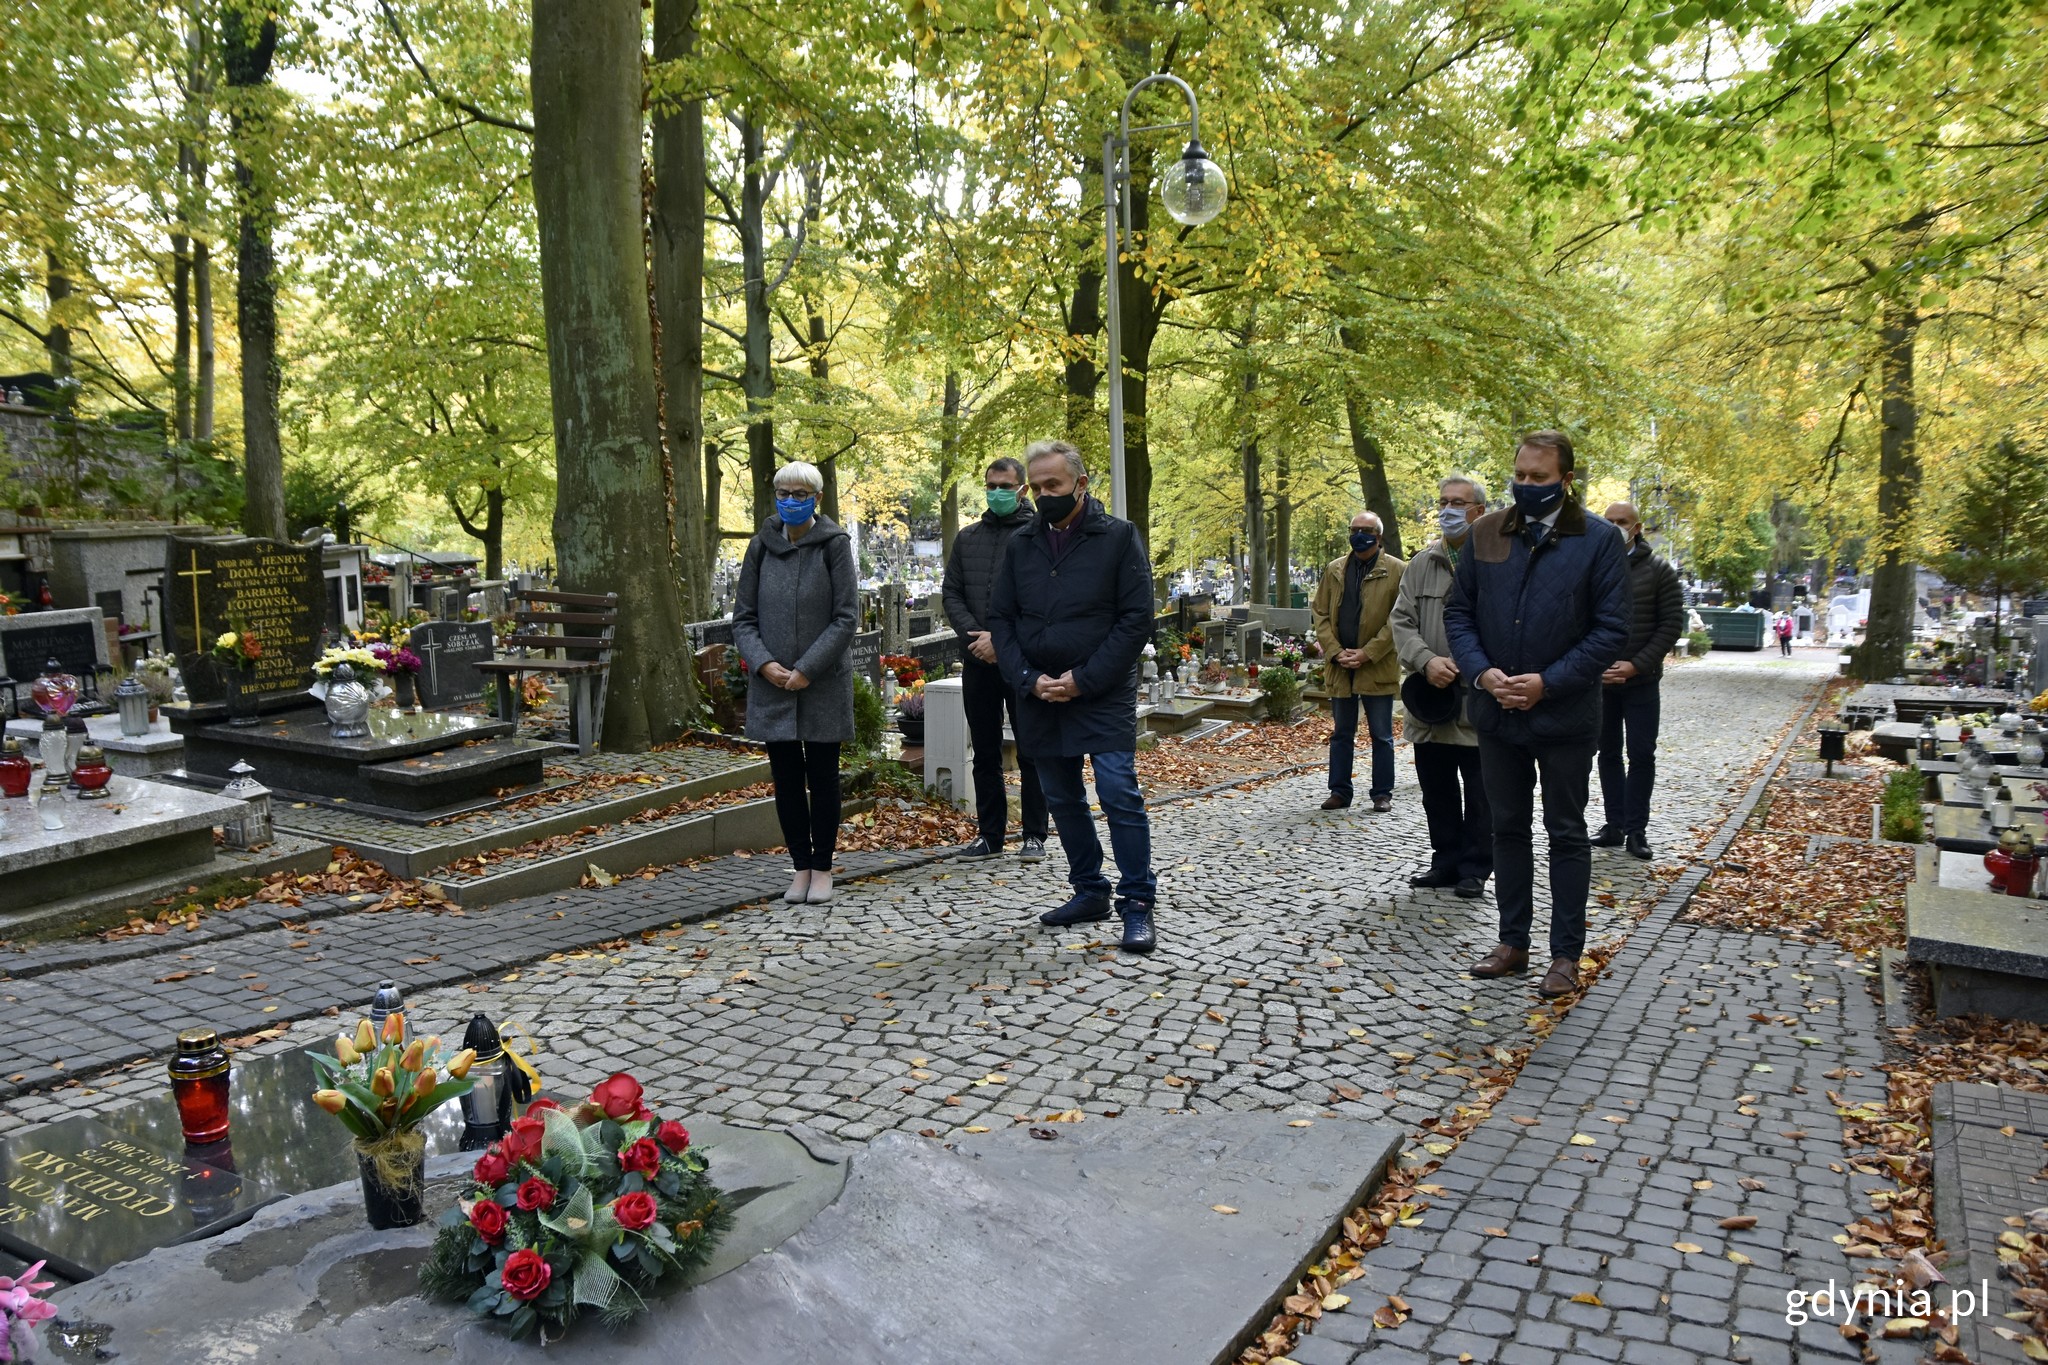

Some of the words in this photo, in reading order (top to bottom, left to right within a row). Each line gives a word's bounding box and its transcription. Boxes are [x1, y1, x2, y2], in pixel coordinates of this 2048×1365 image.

[262, 554, 306, 565] HENRYK
[236, 586, 288, 598] BARBARA
[252, 616, 292, 628] STEFAN
[447, 638, 480, 649] SOBCZAK
[101, 1139, 191, 1174] 28.03.2003
[15, 1149, 175, 1217] CEGIELSKI
[3, 1174, 111, 1221] MARCIN
